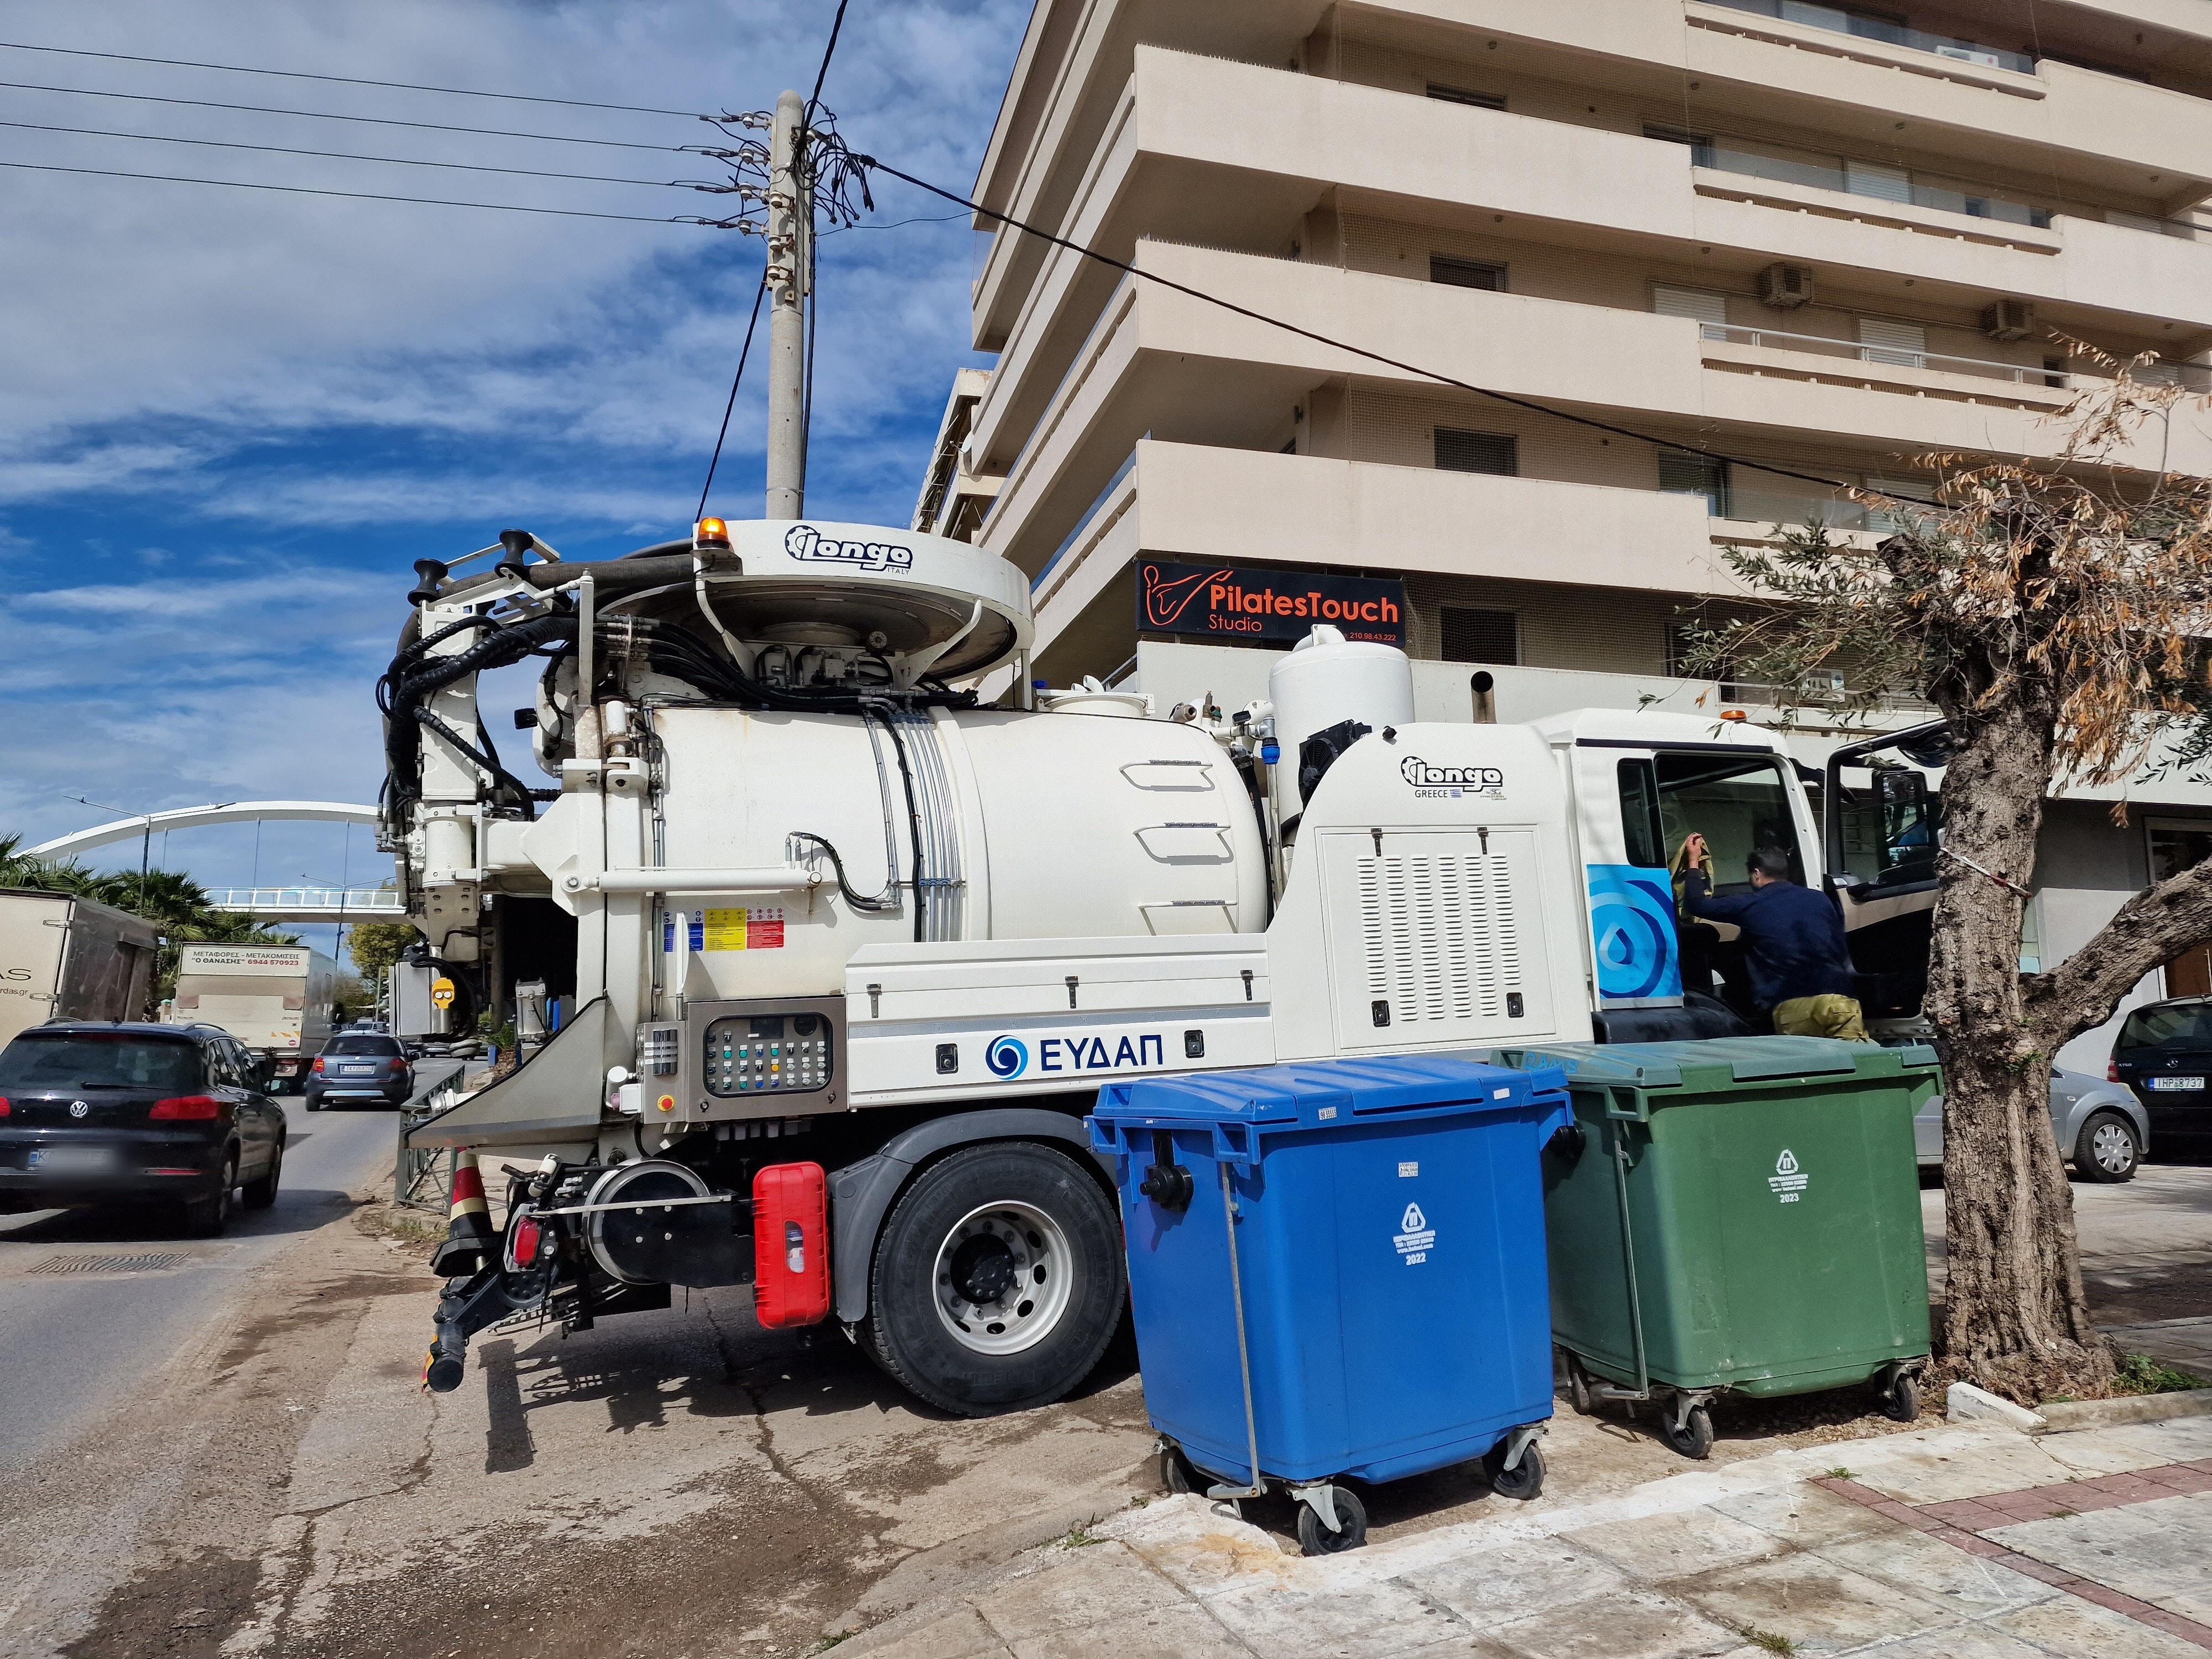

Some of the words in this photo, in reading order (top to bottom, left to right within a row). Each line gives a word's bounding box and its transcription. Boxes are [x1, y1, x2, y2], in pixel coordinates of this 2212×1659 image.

[887, 567, 910, 575] ITALY
[1210, 584, 1398, 623] PilatesTouch
[1208, 613, 1262, 632] Studio
[1415, 789, 1448, 798] GREECE
[1040, 1035, 1163, 1071] ΕΥΔΑΠ
[1780, 1192, 1799, 1203] 2023
[1405, 1252, 1426, 1266] 2022
